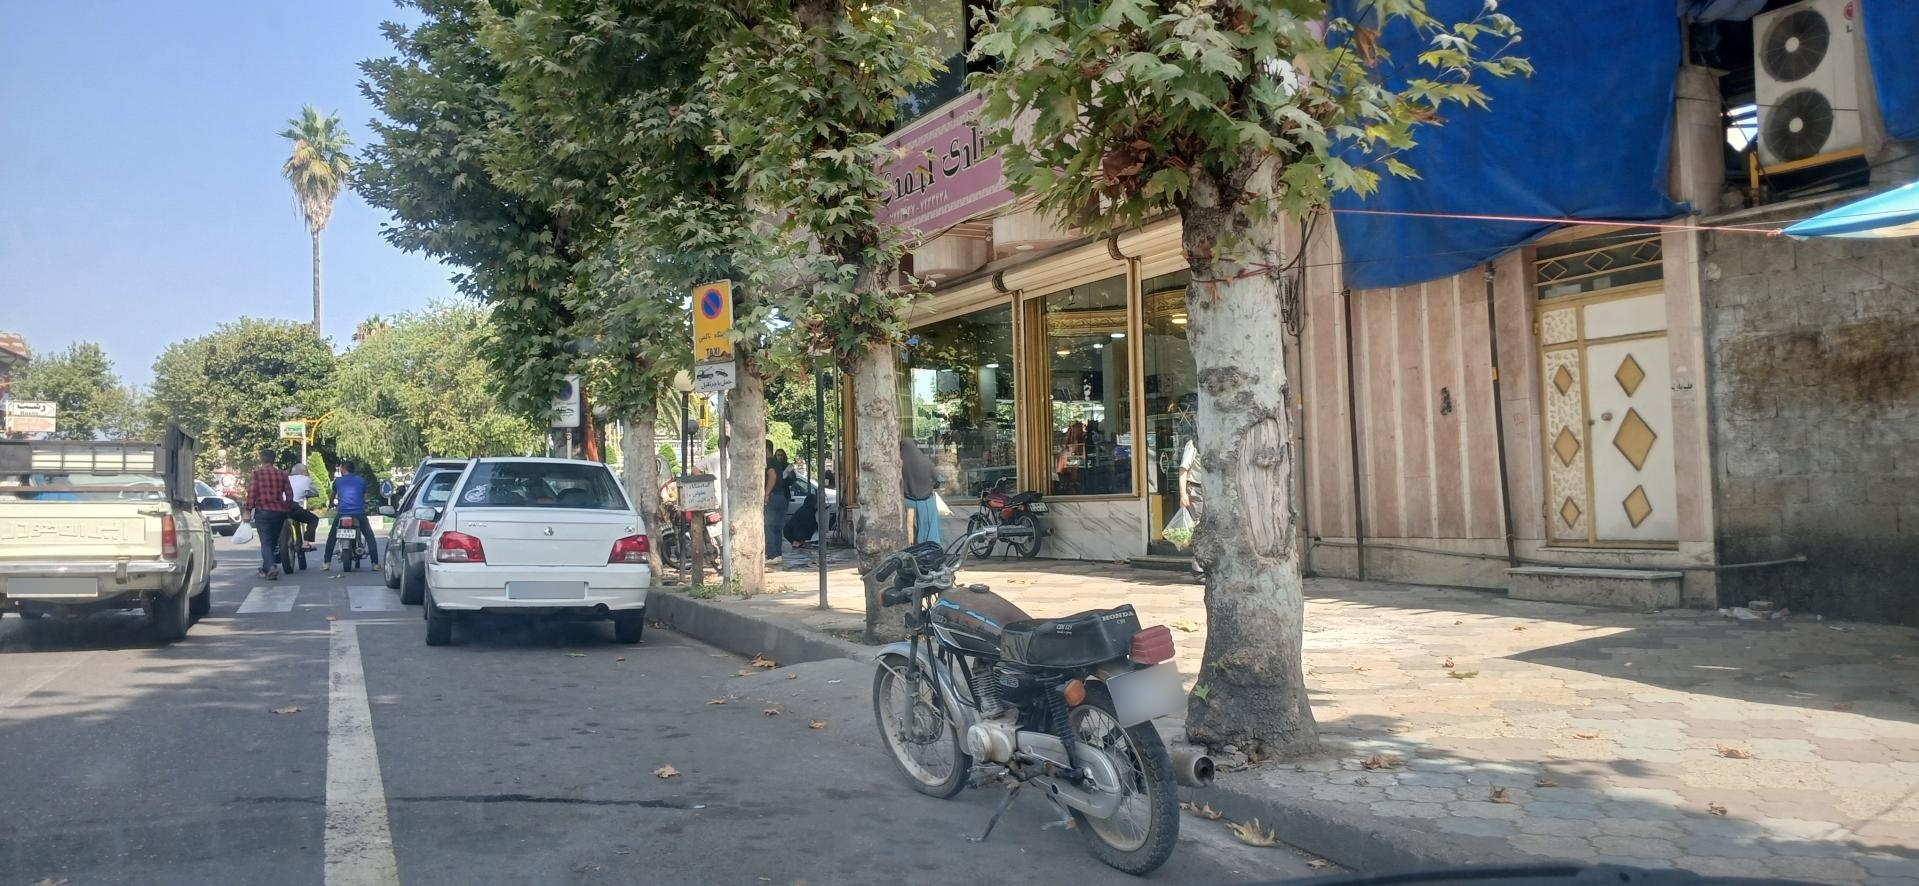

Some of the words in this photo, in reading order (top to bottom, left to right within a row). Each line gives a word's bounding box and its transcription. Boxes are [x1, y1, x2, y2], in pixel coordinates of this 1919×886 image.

[706, 346, 721, 357] TAXI
[17, 403, 46, 412] رشت
[1102, 611, 1134, 622] HONDA
